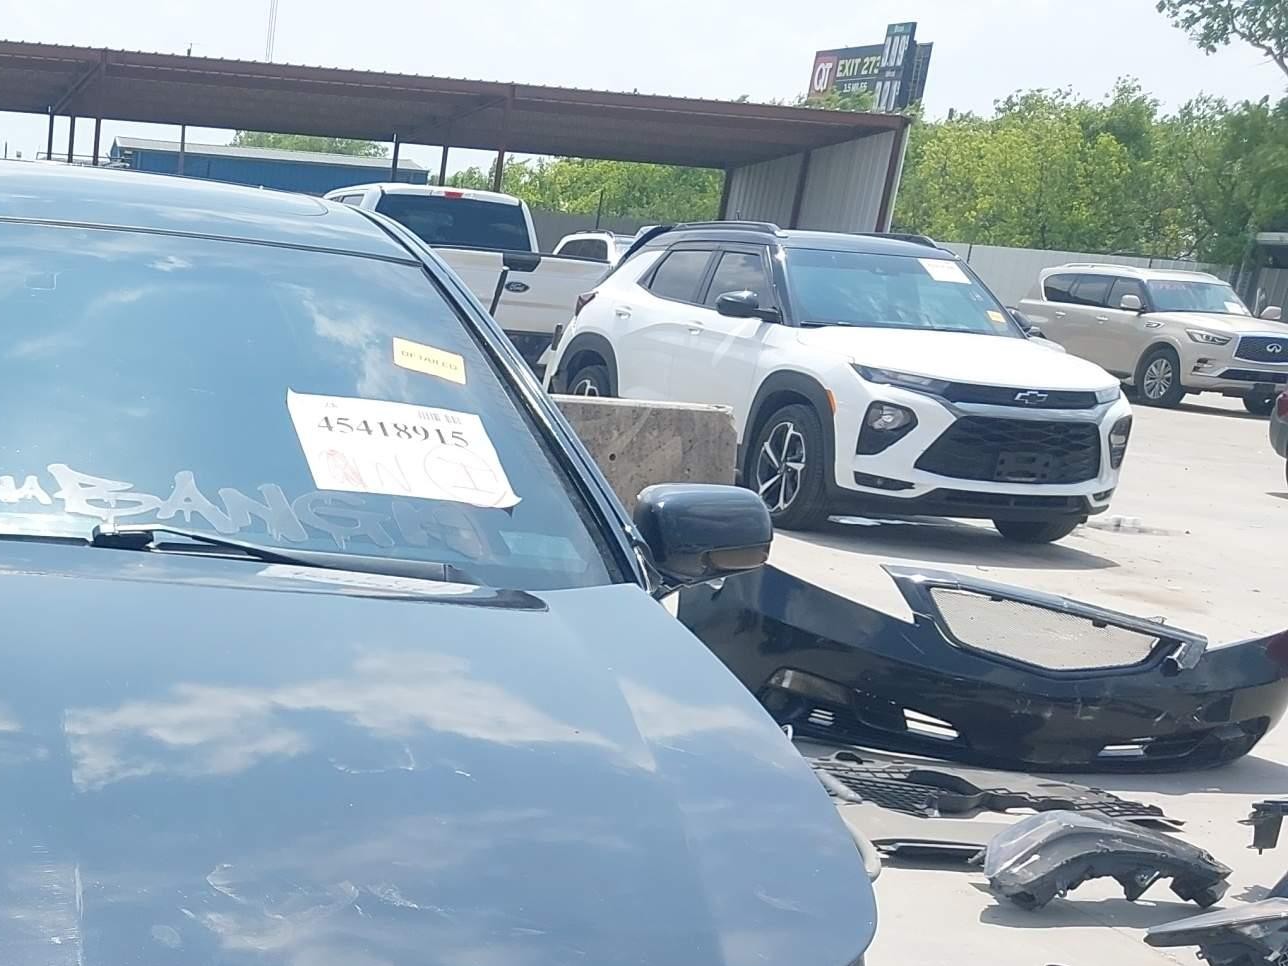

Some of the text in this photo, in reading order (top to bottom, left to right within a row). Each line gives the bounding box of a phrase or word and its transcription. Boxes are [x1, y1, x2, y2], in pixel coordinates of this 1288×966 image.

[814, 62, 832, 92] QT
[836, 58, 861, 77] EXIT
[317, 415, 469, 449] 45418915
